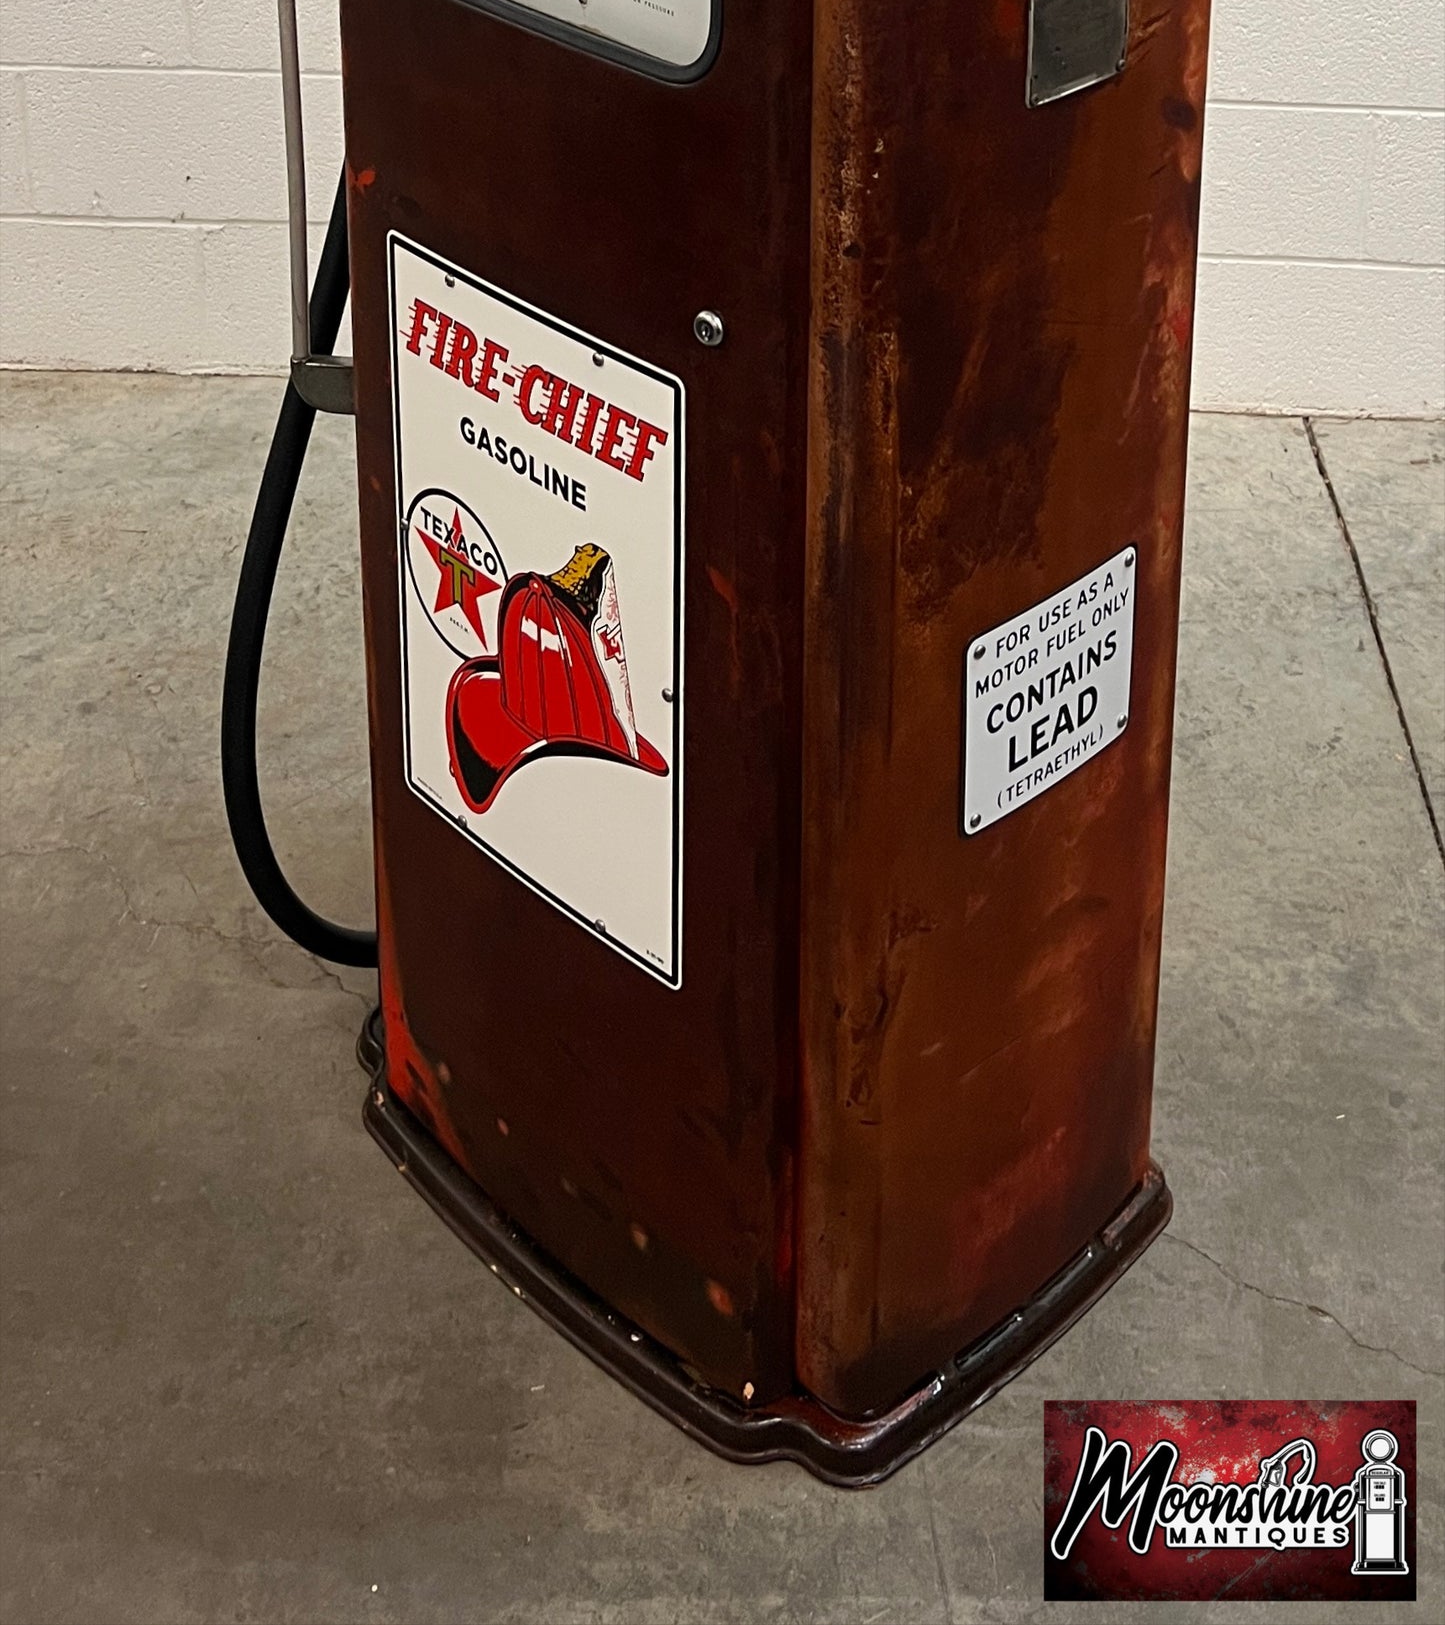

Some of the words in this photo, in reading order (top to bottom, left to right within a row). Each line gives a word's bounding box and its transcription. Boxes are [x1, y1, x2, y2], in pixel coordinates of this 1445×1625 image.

[400, 297, 669, 483] FIRE-CHIEF
[459, 416, 587, 512] GASOLINE
[420, 506, 498, 576] TEXACO
[439, 546, 476, 610] T
[975, 647, 1038, 699] MOTOR
[1046, 619, 1086, 659] FUEL
[1092, 587, 1129, 628] ONLY
[996, 624, 1030, 658] FOR
[1039, 598, 1072, 633] USE
[1077, 581, 1098, 610] AS
[1103, 571, 1114, 593] A
[986, 630, 1118, 735] CONTAINS
[997, 723, 1104, 809] (TETRAETHYL)
[1008, 685, 1099, 773] LEAD
